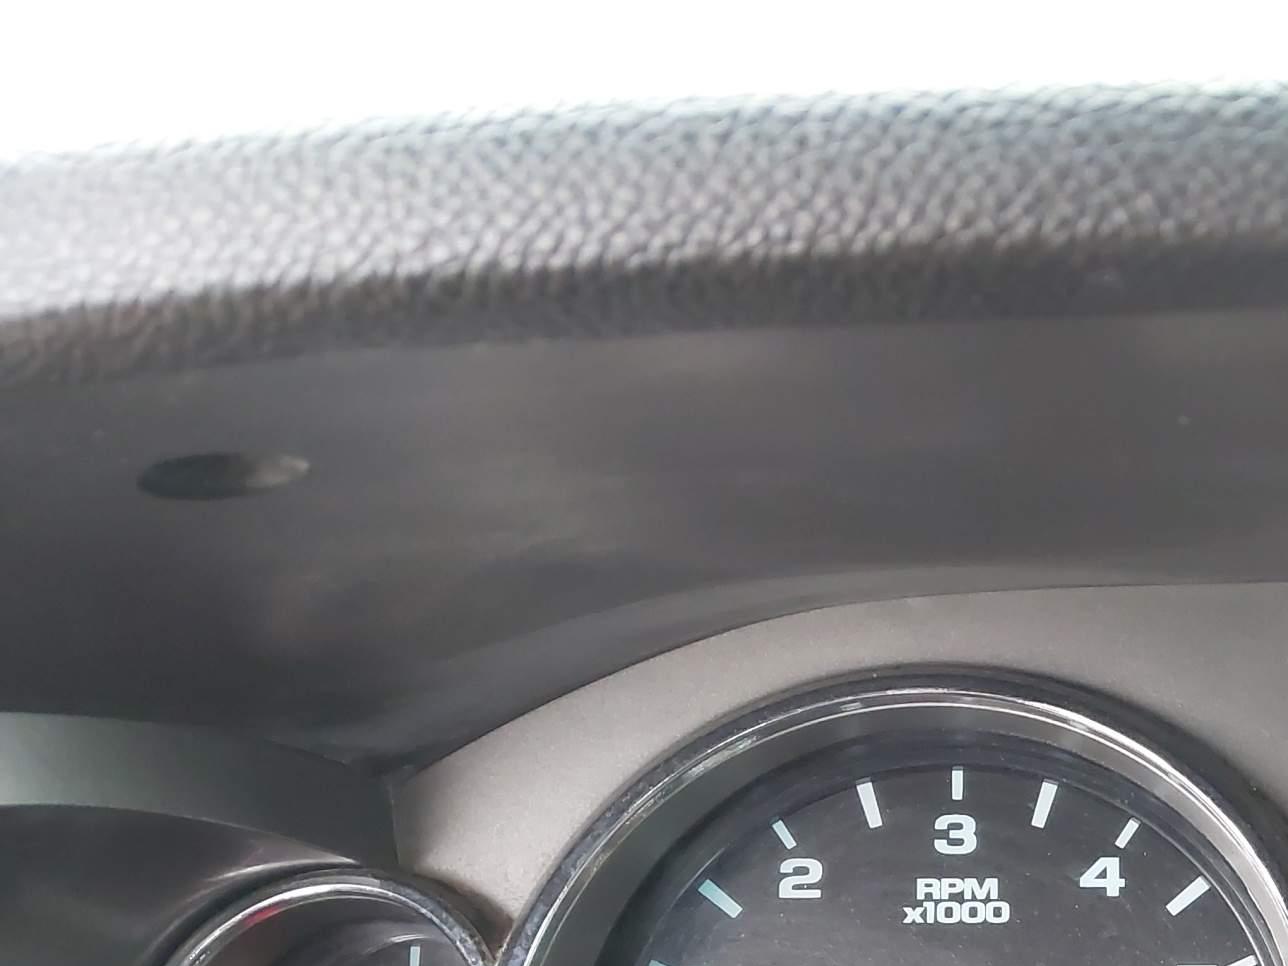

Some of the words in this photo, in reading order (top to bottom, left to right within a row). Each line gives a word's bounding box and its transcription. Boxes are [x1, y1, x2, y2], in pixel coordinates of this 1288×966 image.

[933, 813, 977, 855] 3
[778, 857, 823, 899] 2
[915, 878, 999, 901] RPM
[1079, 856, 1126, 897] 4
[902, 901, 1010, 924] x1000
